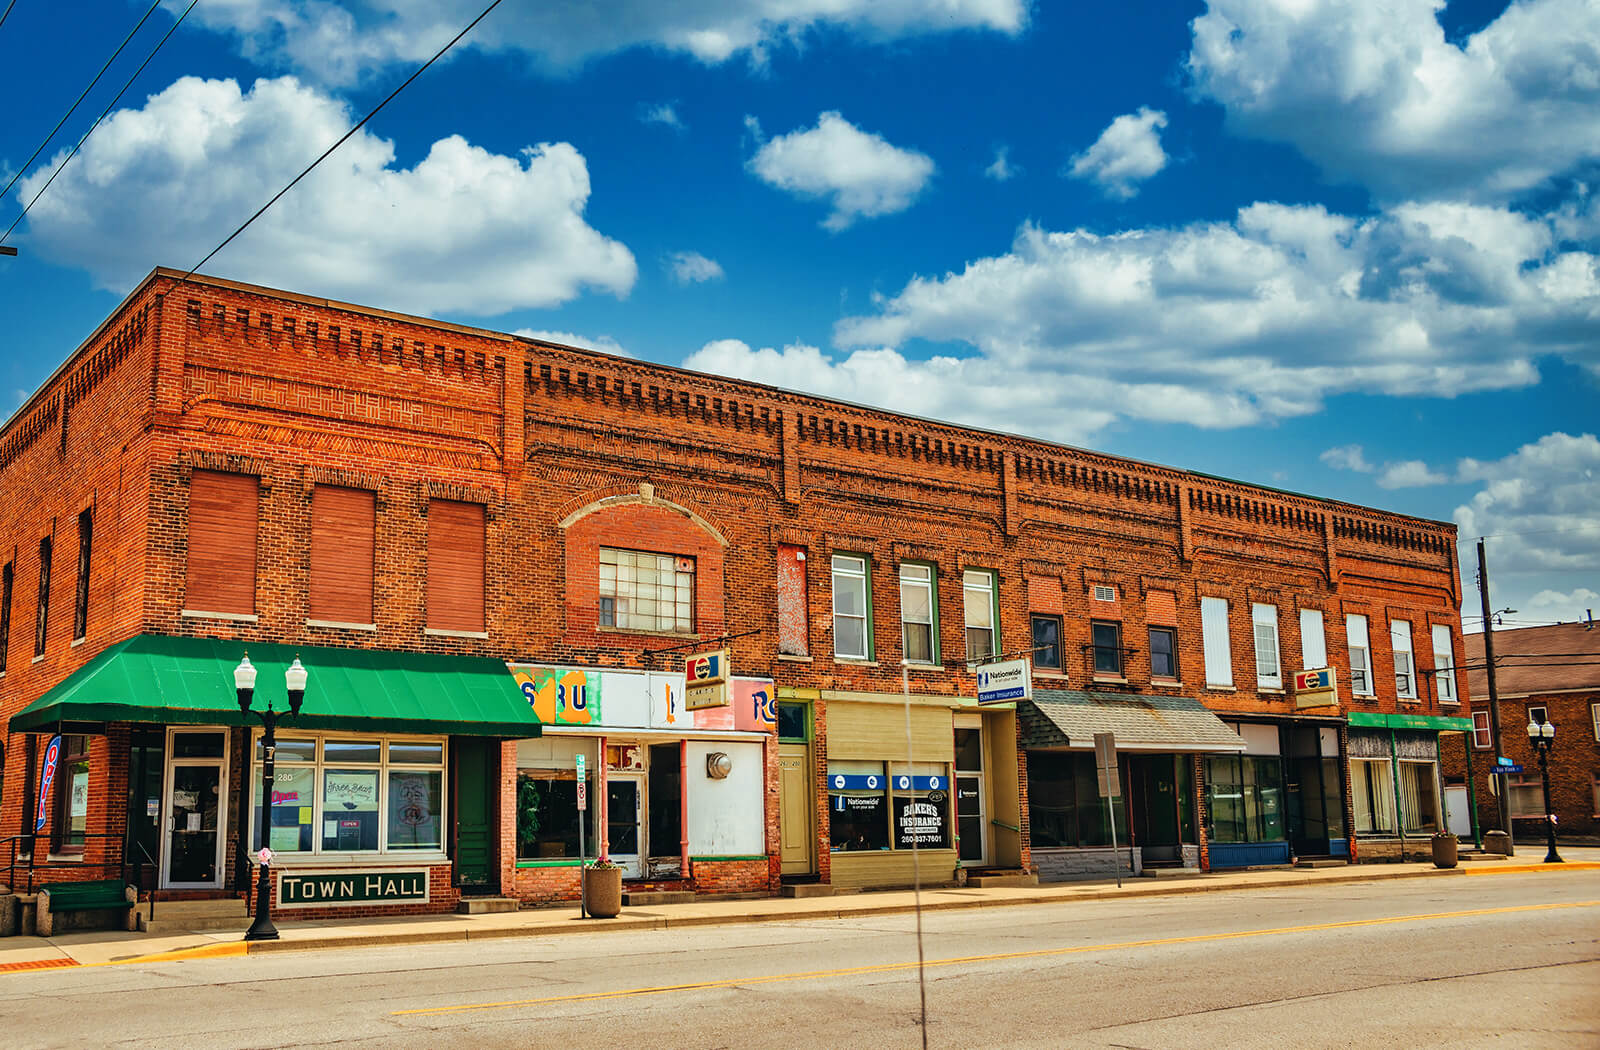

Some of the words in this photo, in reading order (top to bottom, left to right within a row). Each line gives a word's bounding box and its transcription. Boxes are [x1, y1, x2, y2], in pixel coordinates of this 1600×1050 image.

[990, 669, 1021, 679] Nationwide
[980, 693, 996, 701] Baker
[272, 790, 298, 805] Open
[847, 798, 880, 806] Nationwide
[284, 879, 354, 898] TOWN
[365, 876, 424, 897] HALL
